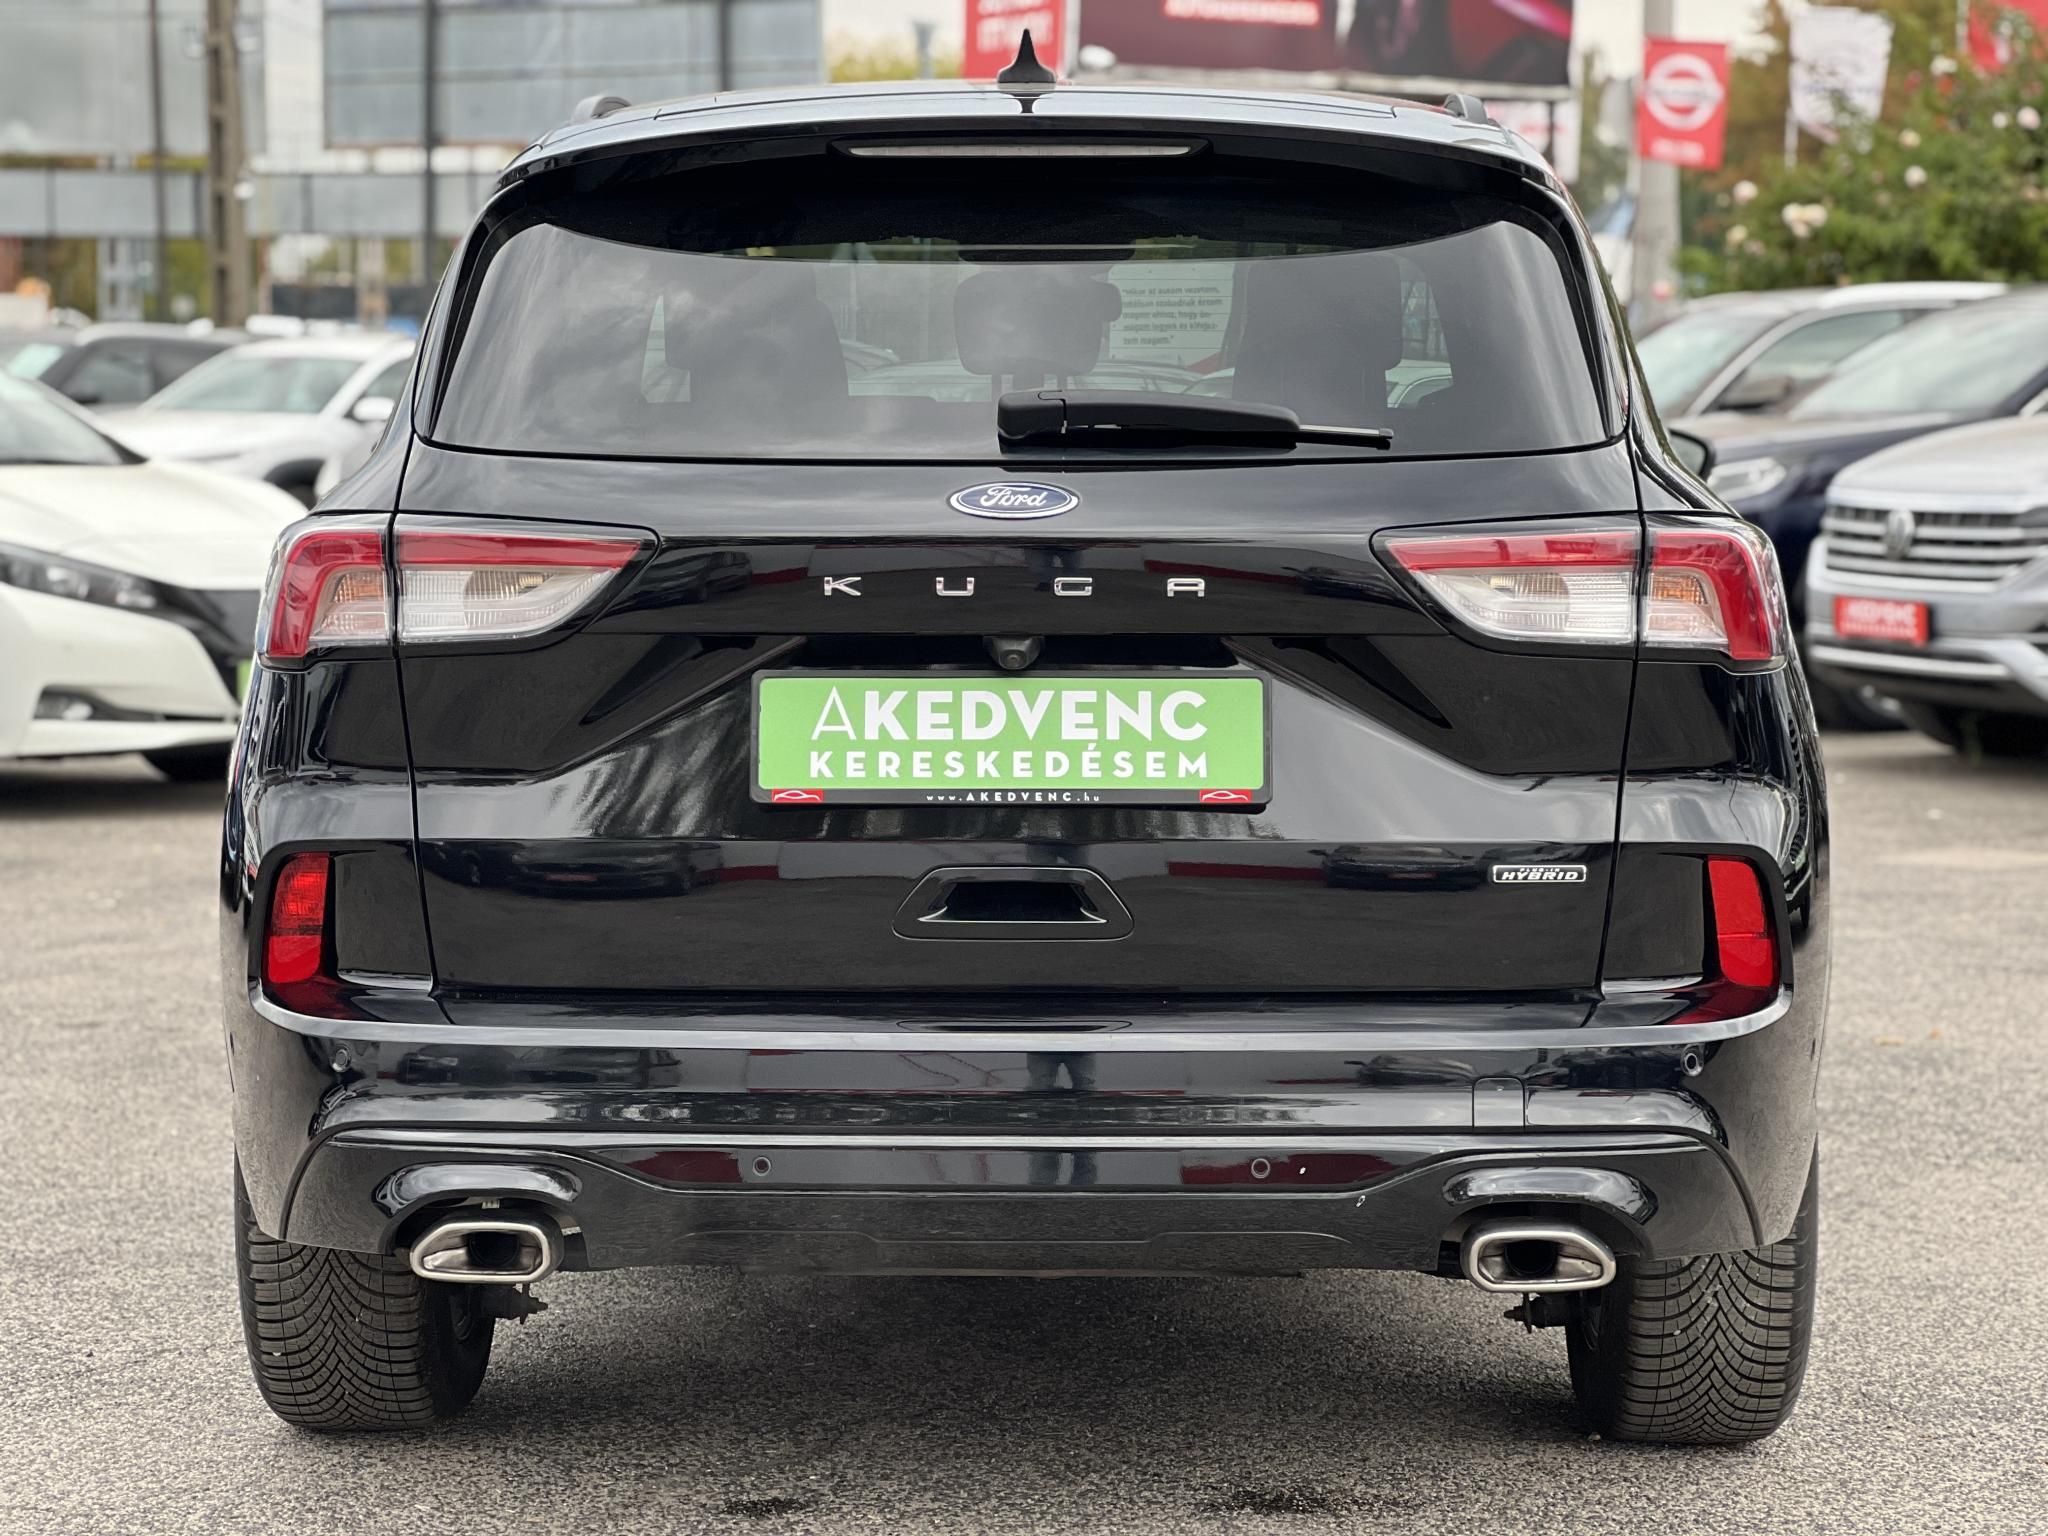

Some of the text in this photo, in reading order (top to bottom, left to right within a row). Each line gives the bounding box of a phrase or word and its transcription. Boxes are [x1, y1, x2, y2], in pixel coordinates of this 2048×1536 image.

[980, 486, 1048, 507] Ford
[824, 577, 1206, 597] KUGA
[809, 743, 1208, 779] KERESKEDÉSEM
[926, 791, 1100, 802] www.AKEDVENC.hu
[1502, 872, 1578, 880] HYBRID
